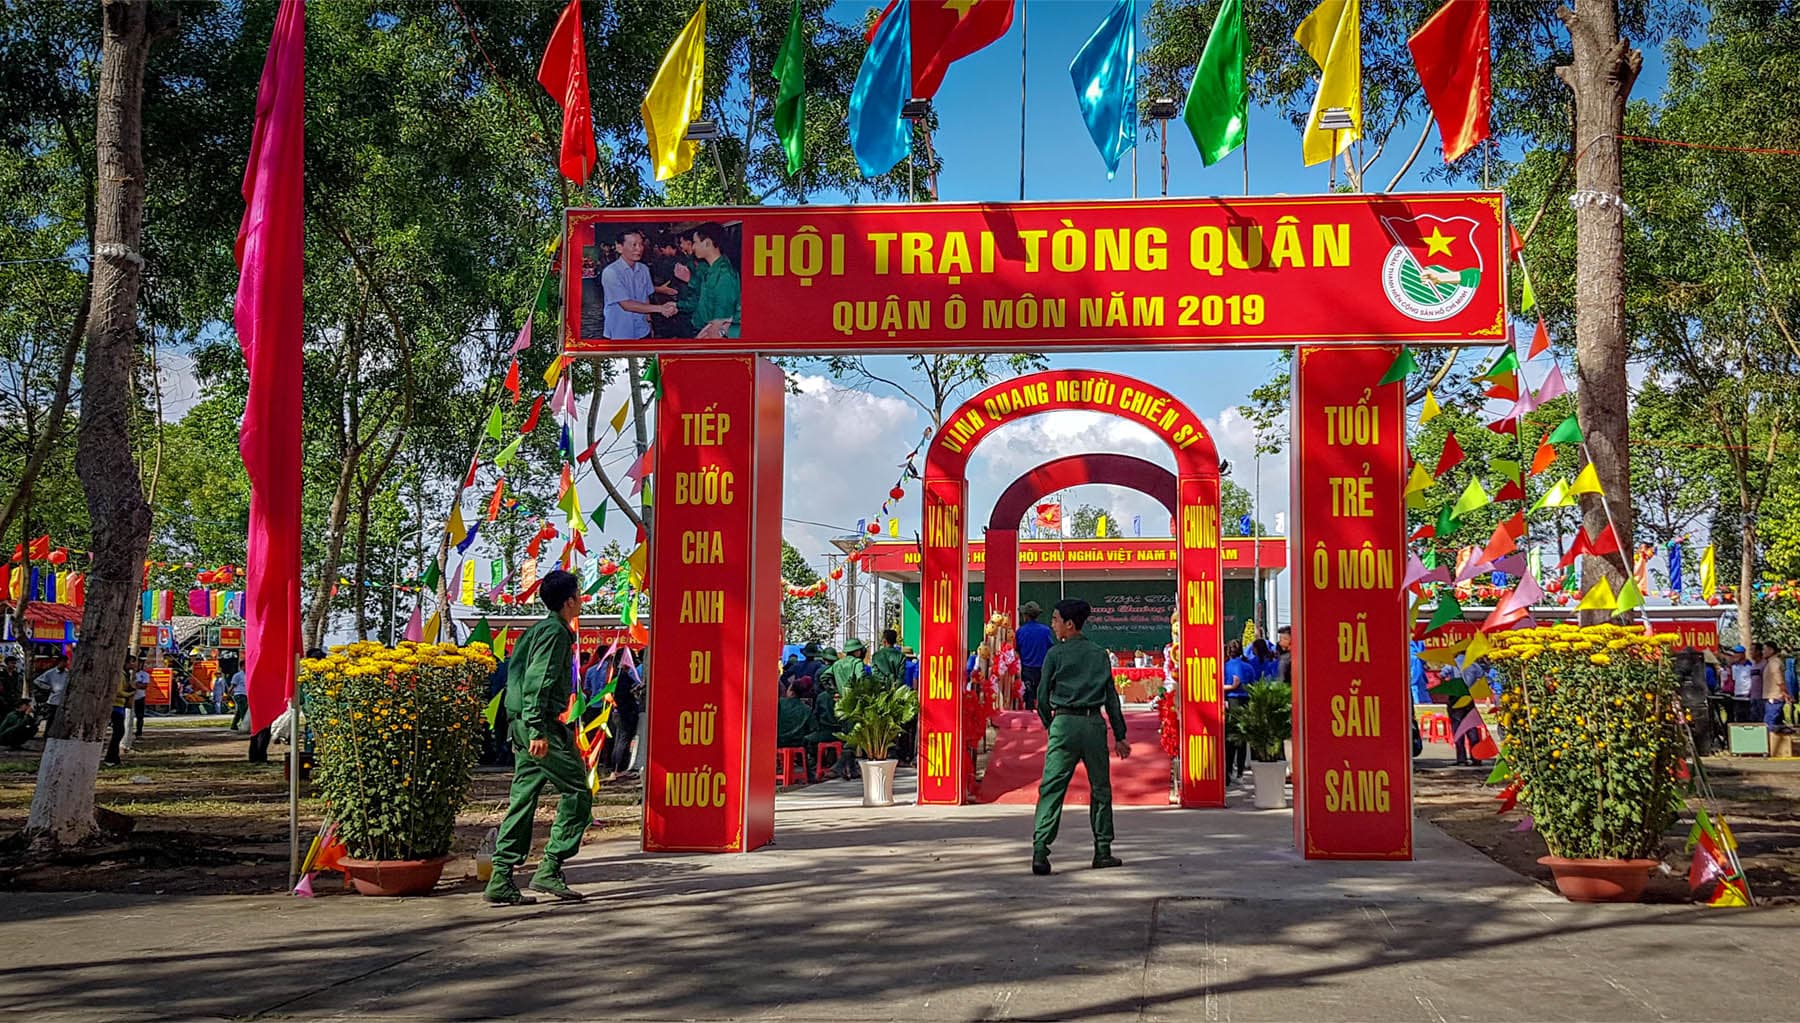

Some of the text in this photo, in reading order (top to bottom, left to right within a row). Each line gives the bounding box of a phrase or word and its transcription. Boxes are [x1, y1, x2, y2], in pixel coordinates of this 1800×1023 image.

[753, 215, 1351, 287] HỘI TRẠI TÒNG QUÂN
[832, 291, 1265, 337] QUẬN Ô MÔN NĂM 2019
[681, 402, 731, 446] TIẾP
[940, 377, 1204, 454] VINH QUANG NGƯỜI CHIẾN SĨ
[1324, 387, 1380, 446] TUỔI
[675, 463, 734, 506] BƯỚC
[1329, 462, 1375, 517] TRẺ
[681, 530, 725, 565] CHA
[928, 496, 959, 548] VÂNG
[1184, 496, 1217, 550] CHÚNG
[1020, 548, 1038, 565] HỘI
[1068, 547, 1103, 562] NGHĨA
[1106, 548, 1133, 564] VIỆT
[1137, 550, 1166, 561] NAM
[1313, 540, 1394, 590] Ô MÔN
[680, 590, 725, 624] ANH
[933, 571, 952, 624] LỜI
[1187, 572, 1215, 626] CHÁU
[1338, 611, 1370, 663] ĐÃ
[689, 650, 711, 684] ĐI
[929, 647, 953, 701] BÁC
[1186, 648, 1217, 703] TÒNG
[678, 704, 717, 746] GIỮ
[1331, 678, 1381, 737] SẴN
[927, 732, 952, 787] DẠY
[1189, 728, 1217, 788] QUÂN
[665, 764, 727, 807] NƯỚC
[1325, 760, 1390, 813] SÀNG
